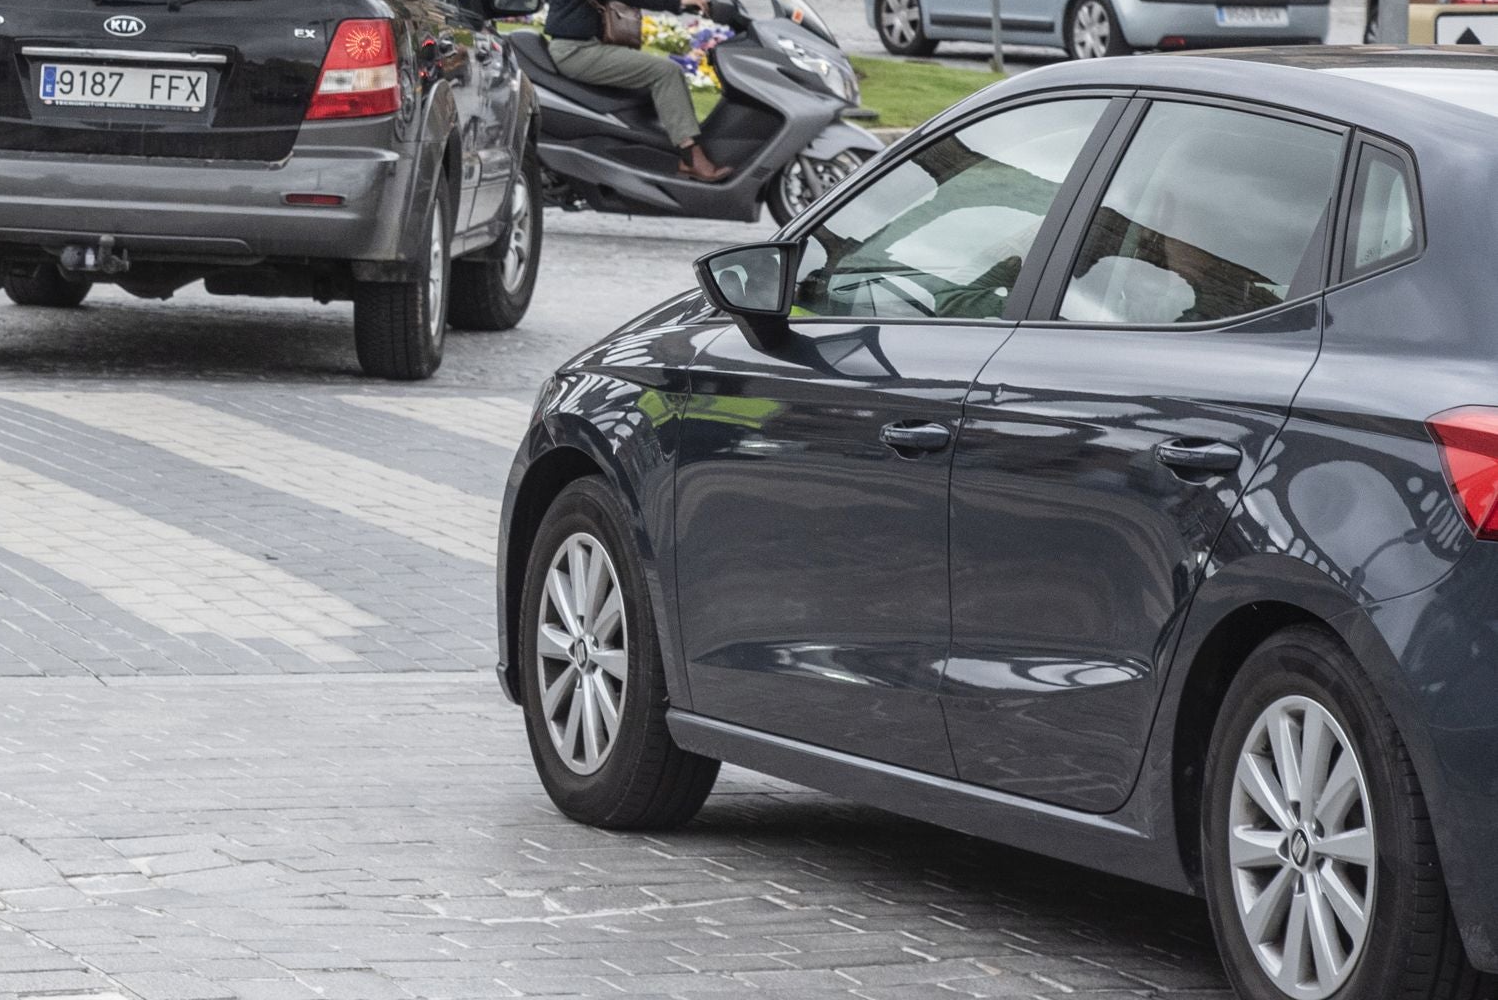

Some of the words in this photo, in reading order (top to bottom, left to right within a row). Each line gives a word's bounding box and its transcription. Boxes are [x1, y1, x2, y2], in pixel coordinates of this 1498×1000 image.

[110, 19, 139, 32] KIA
[294, 28, 316, 39] EX
[59, 70, 124, 98] 9187
[150, 74, 202, 102] FFX
